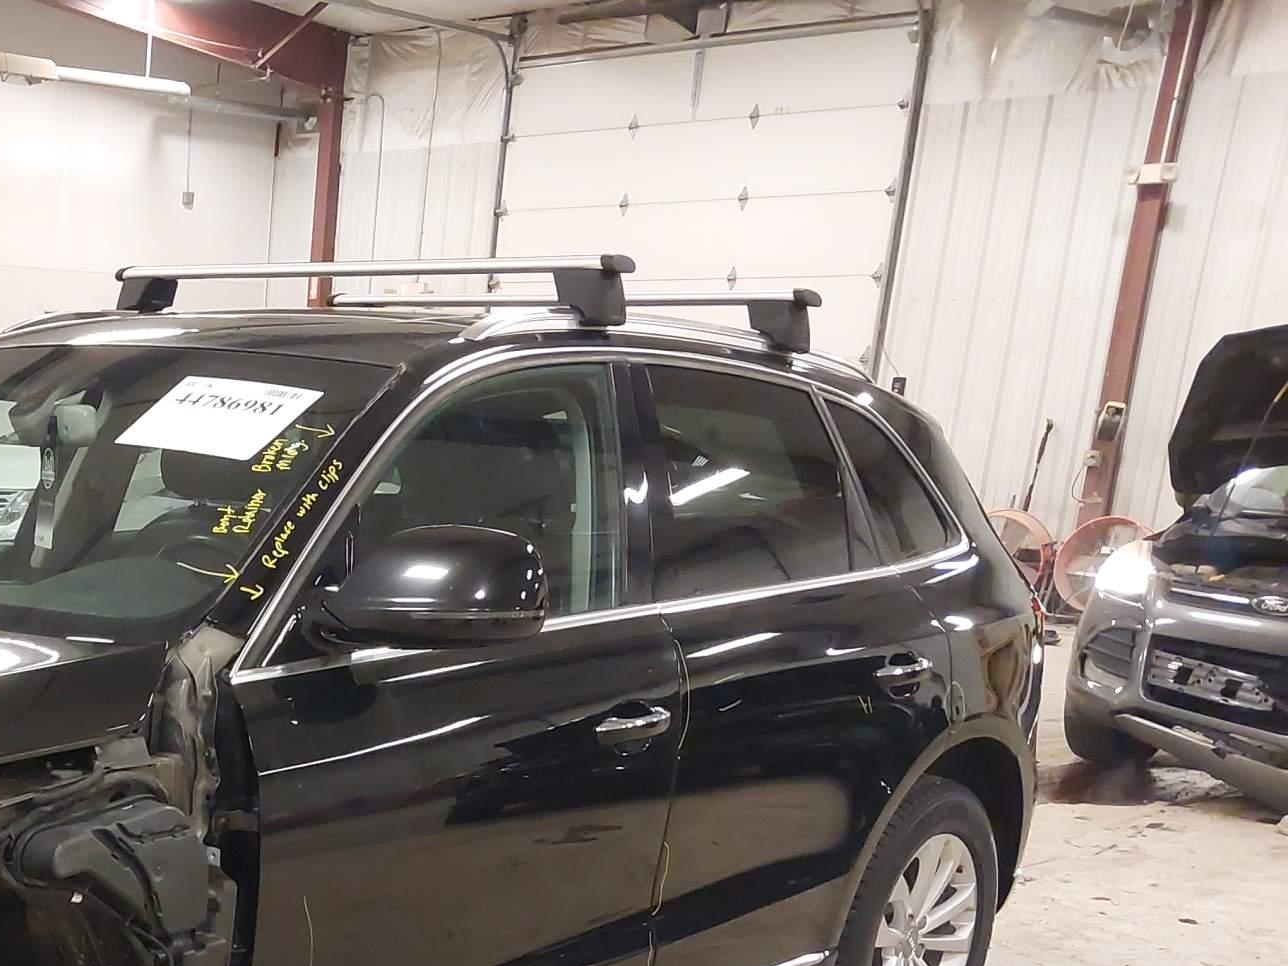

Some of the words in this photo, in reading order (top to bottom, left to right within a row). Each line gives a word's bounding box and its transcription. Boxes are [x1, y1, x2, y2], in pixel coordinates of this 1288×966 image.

[175, 391, 286, 416] 44786981
[261, 520, 296, 569] Replace
[295, 492, 319, 518] with
